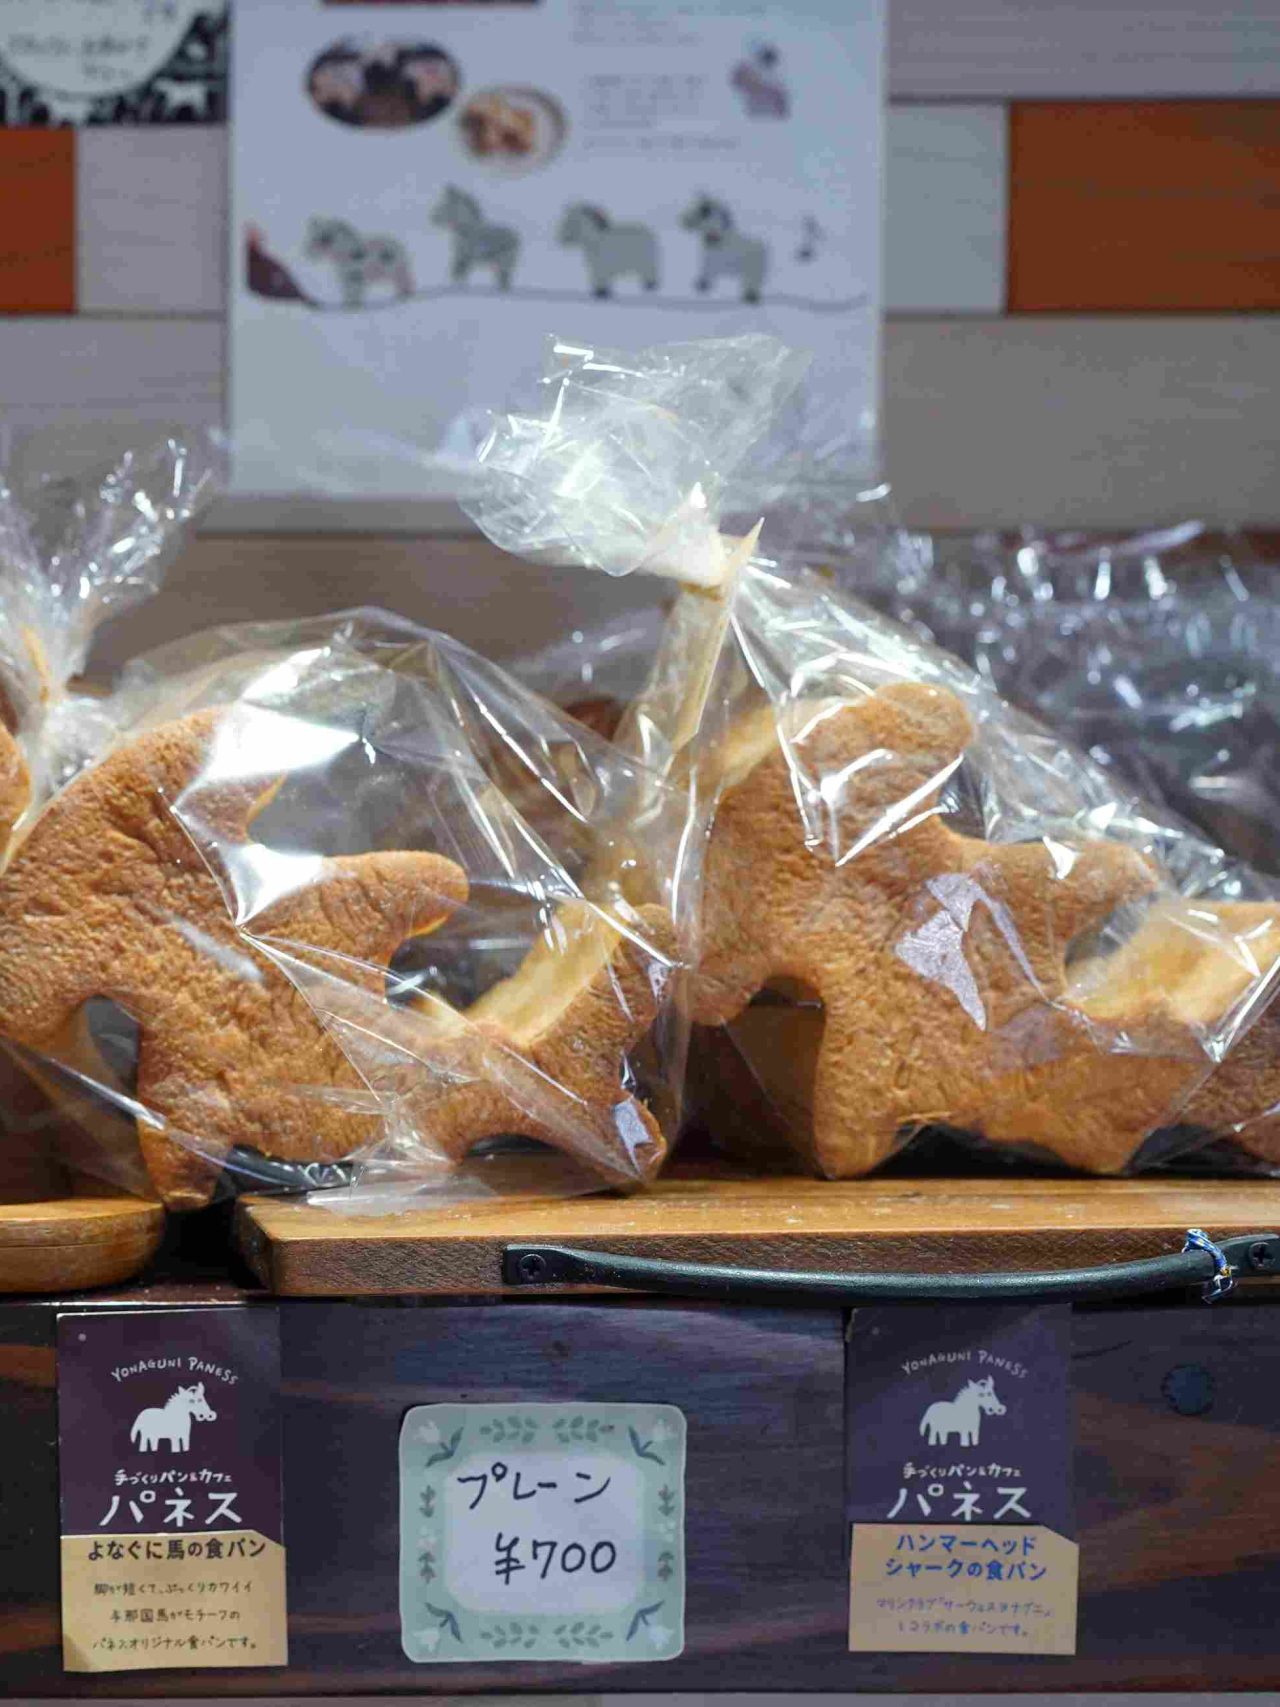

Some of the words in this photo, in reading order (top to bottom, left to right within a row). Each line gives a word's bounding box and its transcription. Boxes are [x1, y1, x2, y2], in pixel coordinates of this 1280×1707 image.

[111, 1357, 181, 1383] YONAGUNI
[188, 1356, 239, 1386] PANESS
[901, 1351, 971, 1376] YONAGUNI
[978, 1350, 1029, 1379] PANESS
[457, 1462, 612, 1510] プレーン
[886, 1481, 1032, 1521] パネス
[99, 1487, 243, 1527] パネス
[87, 1538, 267, 1561] よなぐに馬の食パン
[494, 1532, 617, 1585] ¥700
[896, 1533, 1037, 1556] ハンマーヘッド
[885, 1558, 1047, 1581] シャークの食パン
